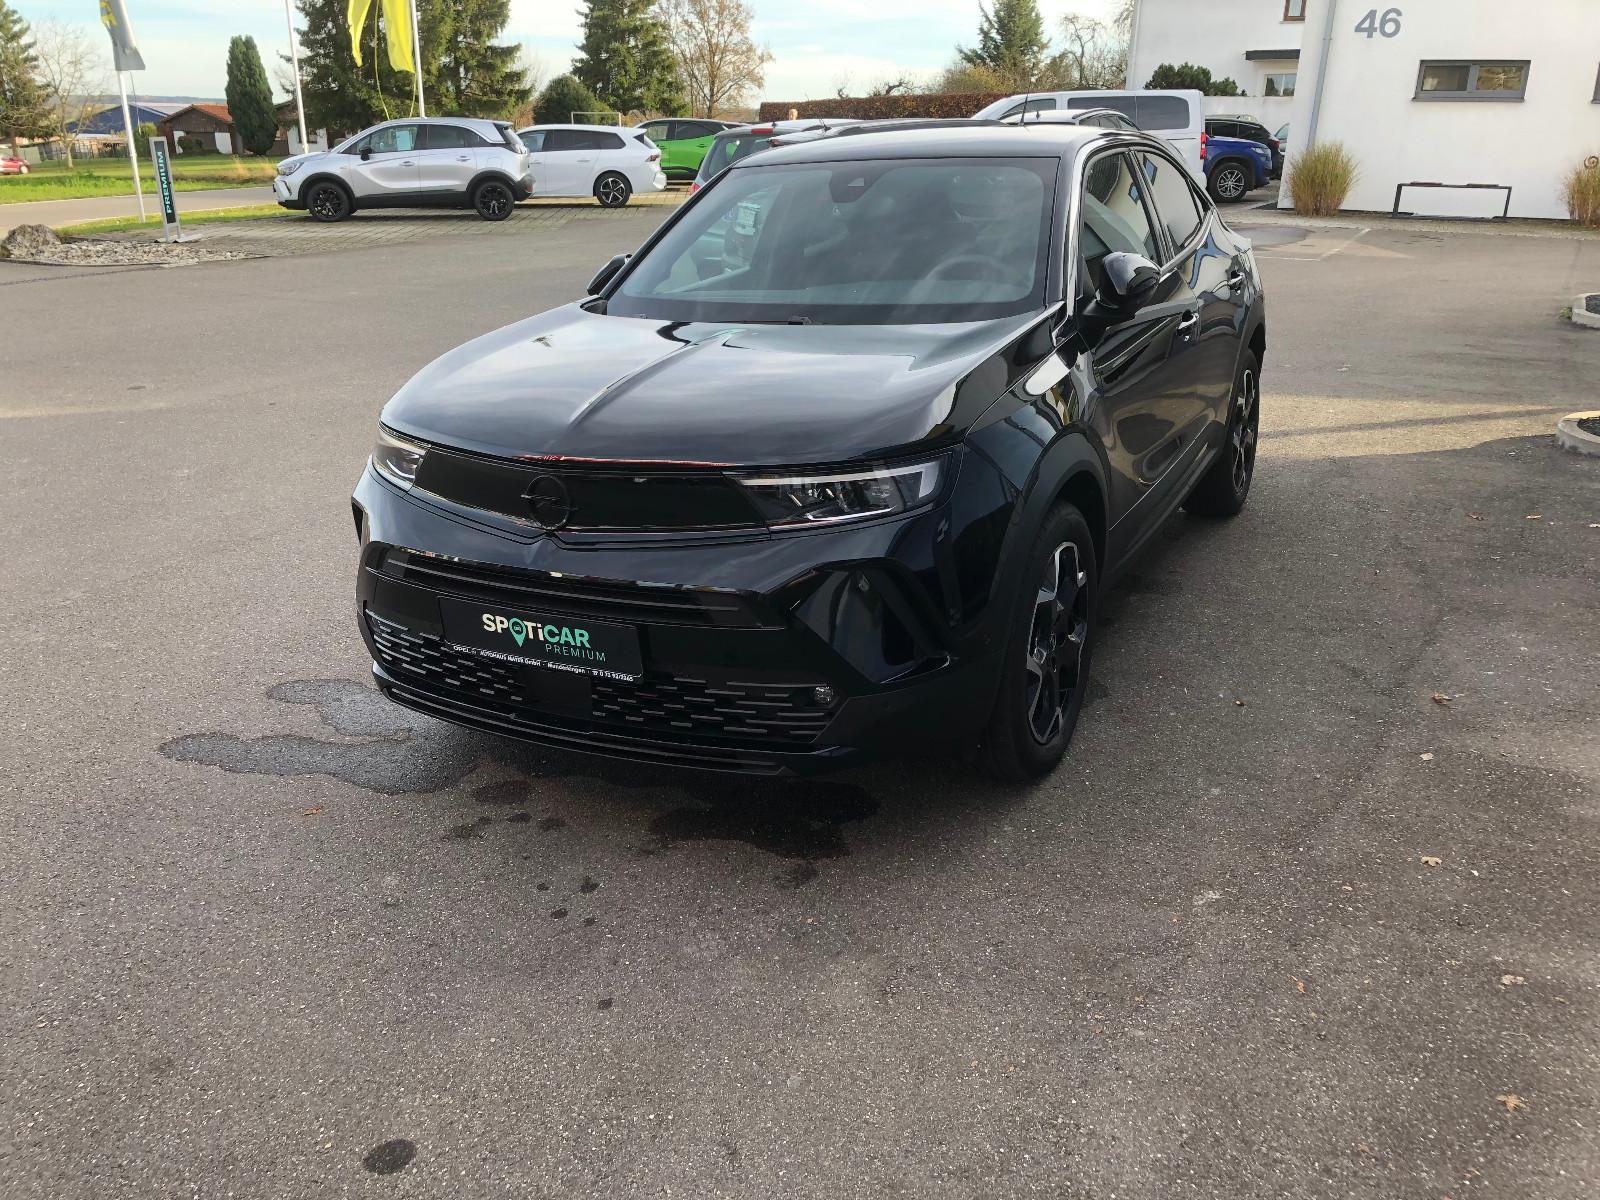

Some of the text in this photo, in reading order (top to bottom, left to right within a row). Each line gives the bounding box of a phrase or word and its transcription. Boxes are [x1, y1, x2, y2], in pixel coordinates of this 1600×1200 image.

[1354, 8, 1403, 39] 46
[157, 151, 172, 214] PREMIUM
[525, 658, 541, 667] GmbH
[545, 643, 606, 662] PREMIUM
